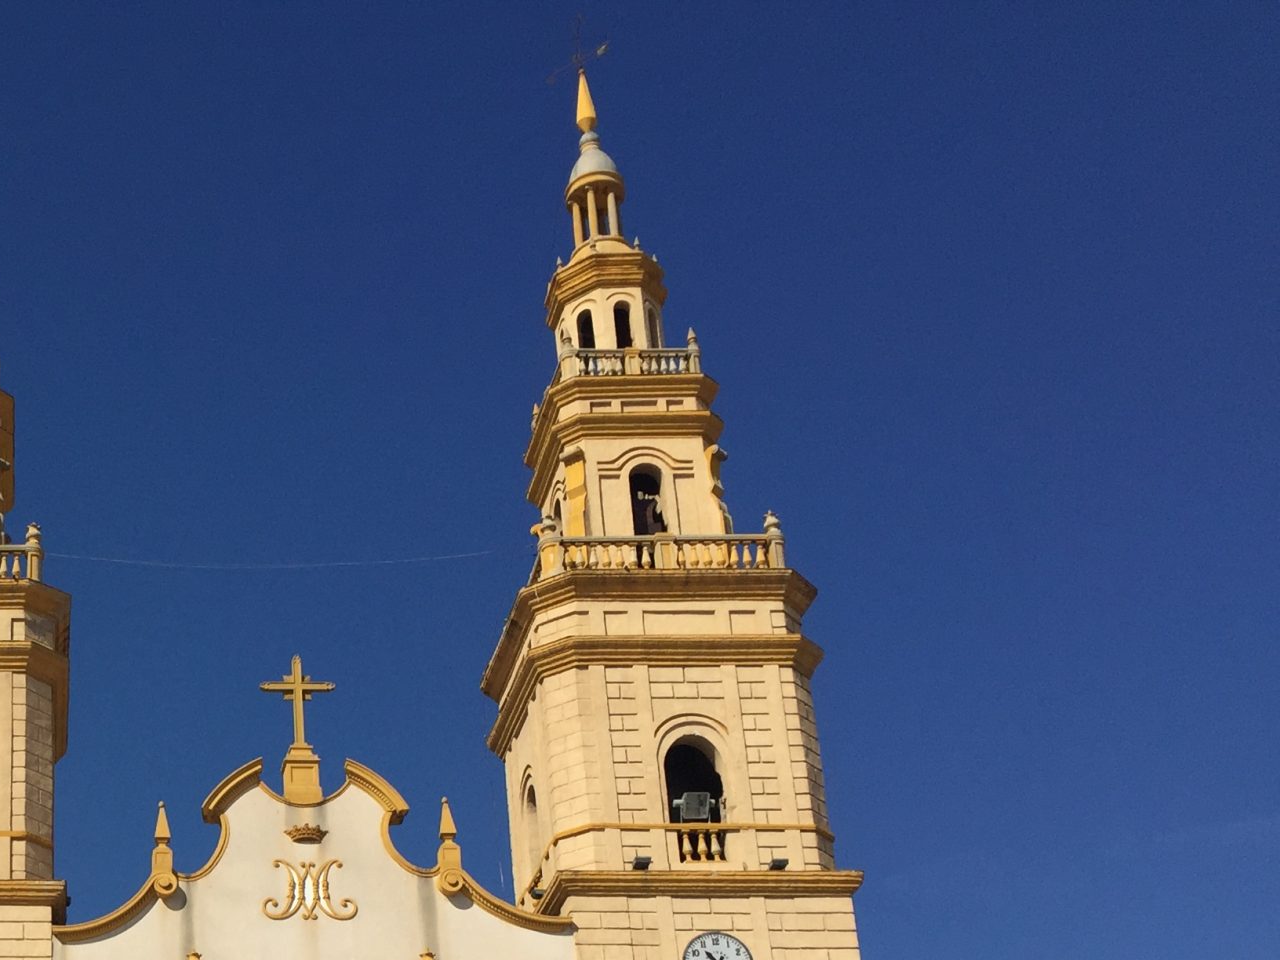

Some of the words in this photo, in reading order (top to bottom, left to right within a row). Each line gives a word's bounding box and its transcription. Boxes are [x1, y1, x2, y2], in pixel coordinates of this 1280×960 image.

[700, 940, 706, 948] 11
[712, 937, 720, 946] 12
[692, 949, 700, 957] 10
[735, 948, 741, 956] 2
